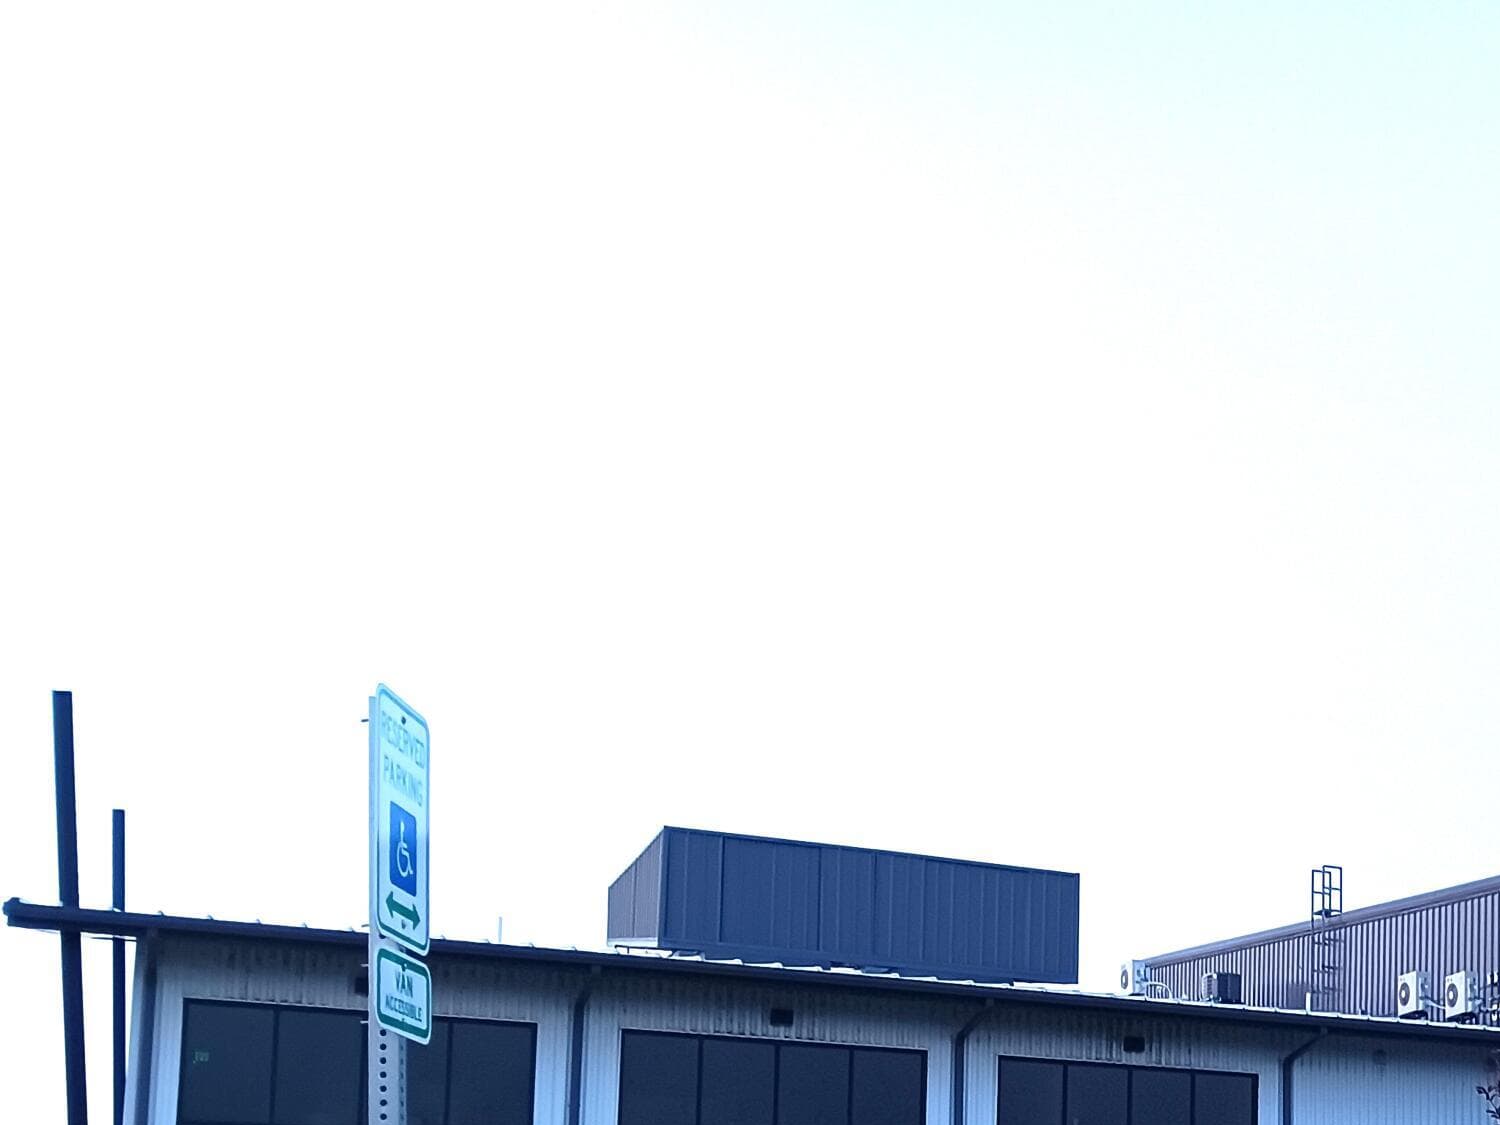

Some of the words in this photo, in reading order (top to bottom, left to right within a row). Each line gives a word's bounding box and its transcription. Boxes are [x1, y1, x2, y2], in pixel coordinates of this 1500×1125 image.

[384, 754, 422, 807] PARKING
[395, 971, 414, 998] VAN
[385, 995, 422, 1022] ACCESSIBLE
